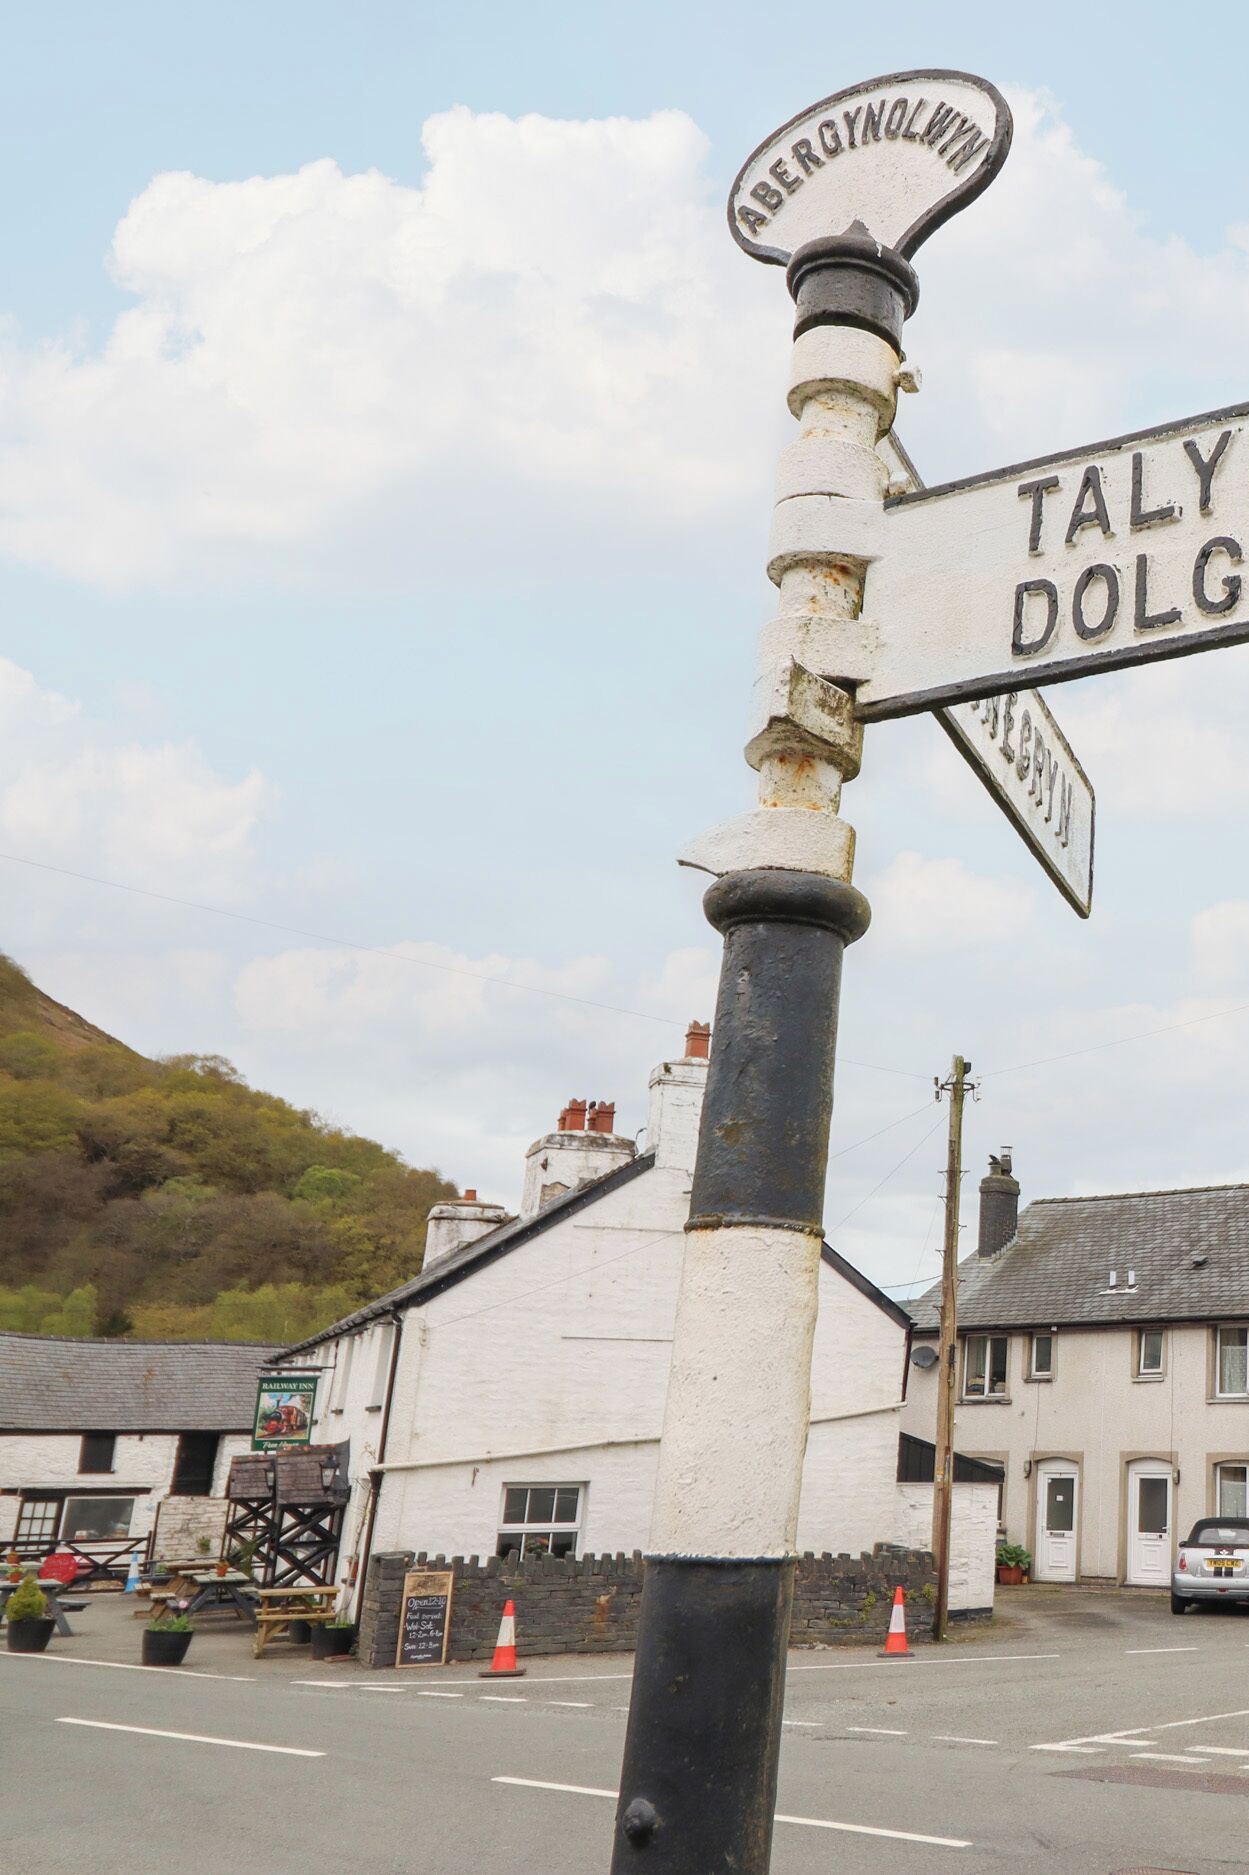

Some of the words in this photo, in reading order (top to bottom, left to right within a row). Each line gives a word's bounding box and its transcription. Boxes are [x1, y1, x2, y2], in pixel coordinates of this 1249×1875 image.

[737, 97, 993, 236] ABERGYNOLWYN
[970, 689, 1073, 849] EGRYN
[262, 1382, 298, 1390] RAILWAY
[299, 1382, 315, 1390] INN
[407, 1598, 428, 1611] Open
